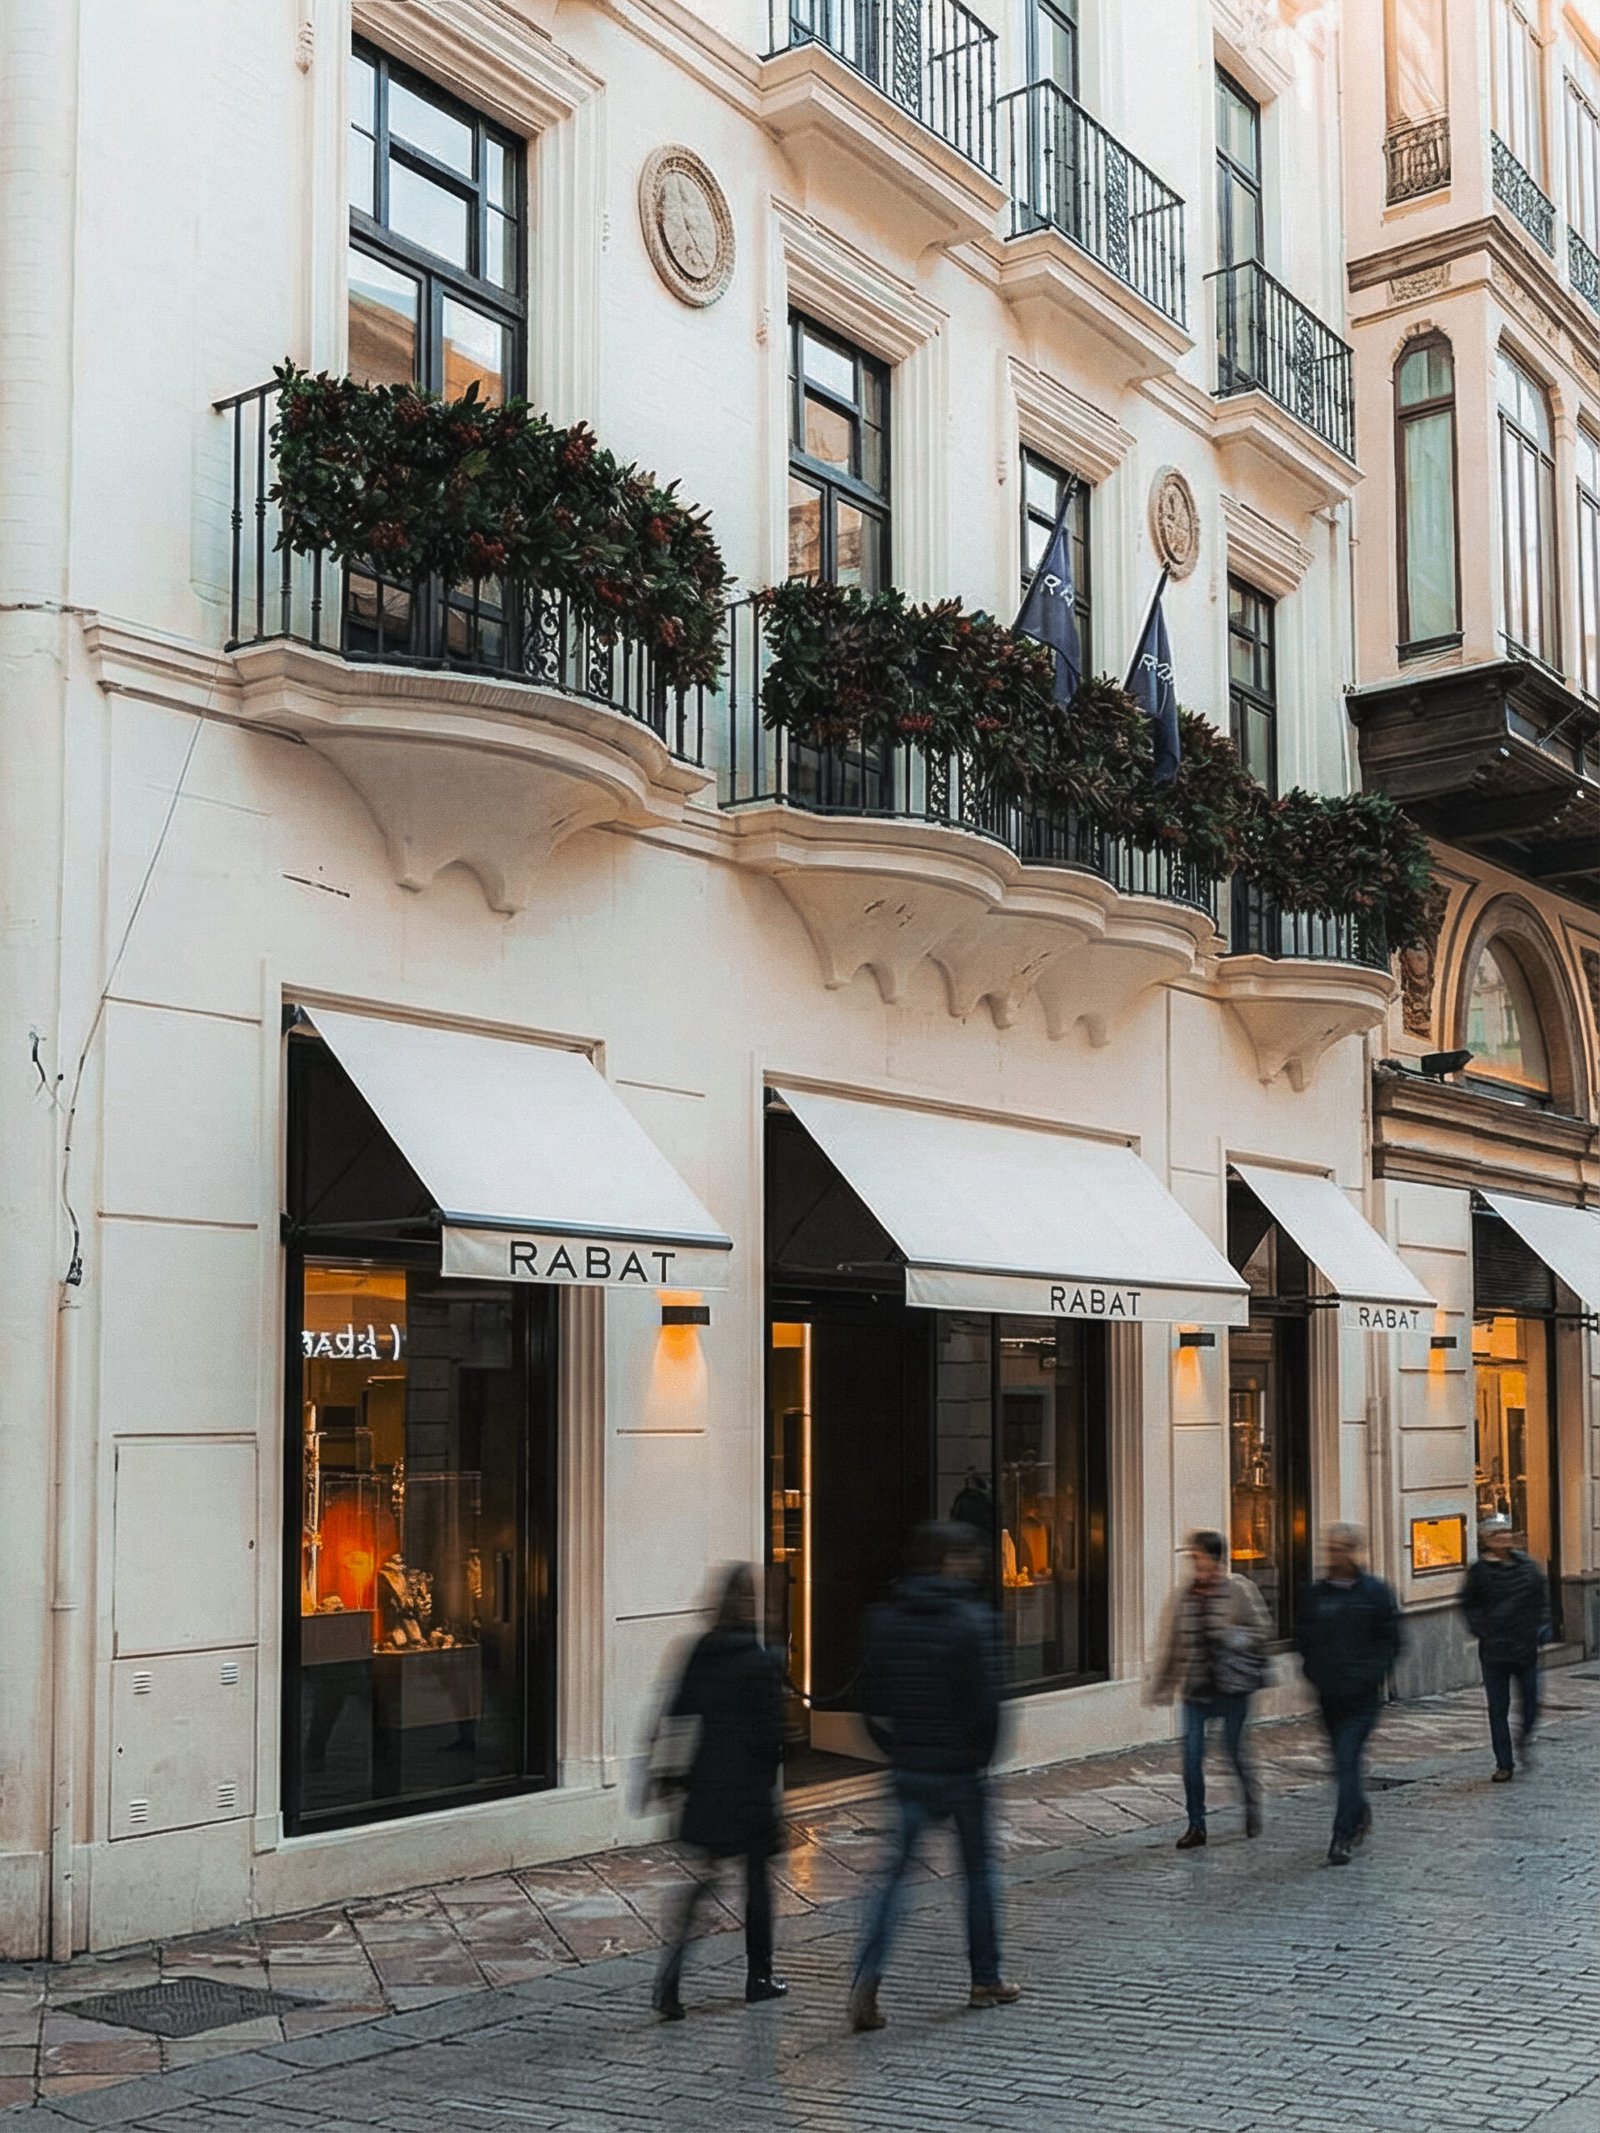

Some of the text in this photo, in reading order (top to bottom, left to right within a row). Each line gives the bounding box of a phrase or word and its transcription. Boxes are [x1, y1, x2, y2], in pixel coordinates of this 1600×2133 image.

[510, 1240, 676, 1283] RABAT
[1050, 1286, 1141, 1316] RABAT
[1359, 1306, 1420, 1330] RABAT
